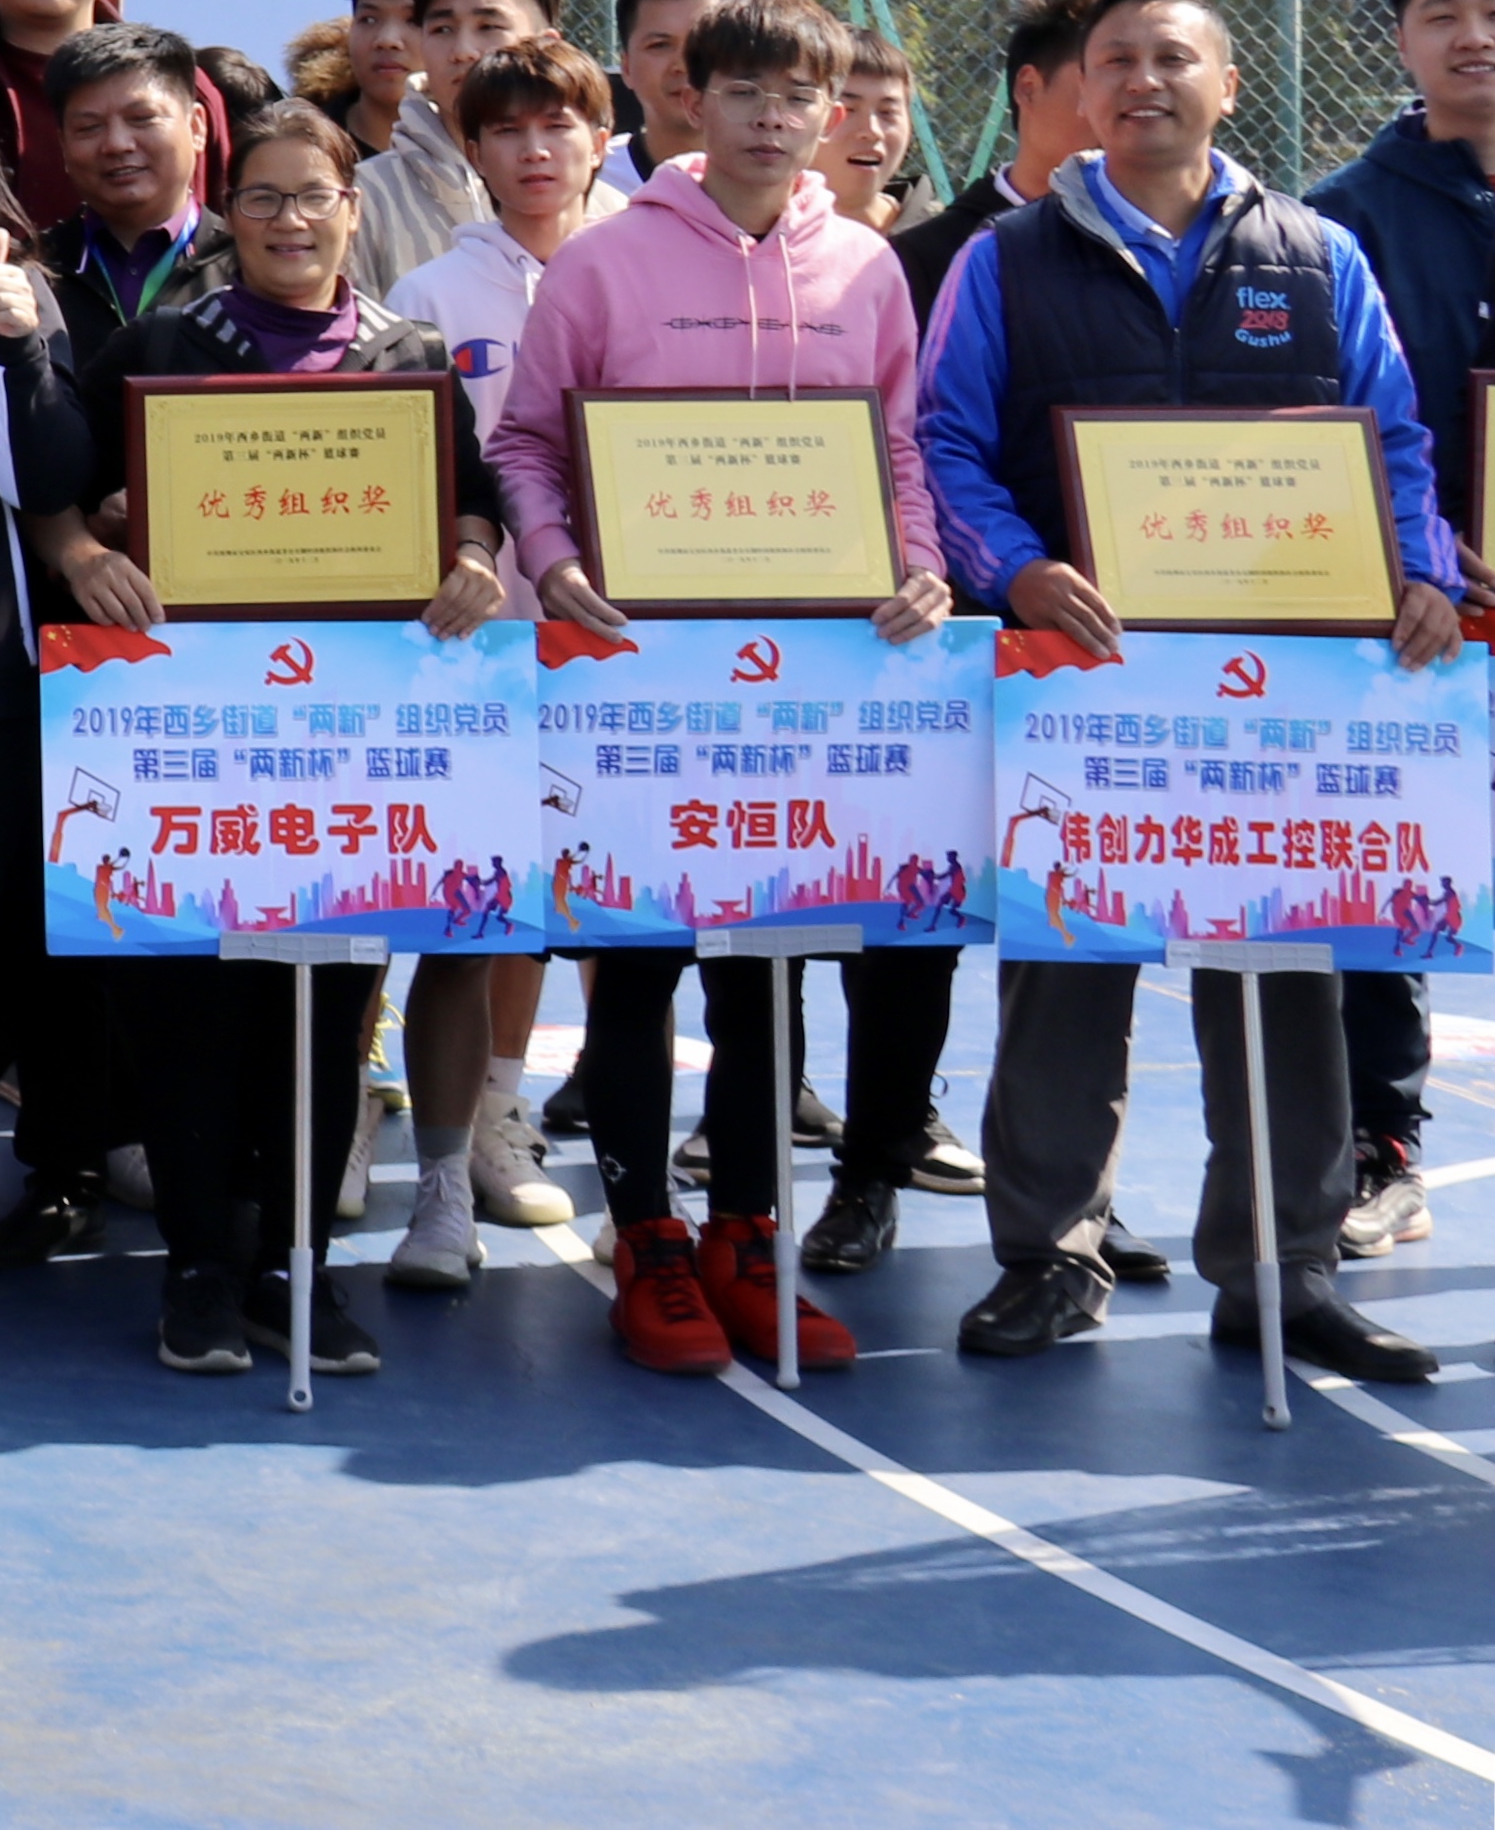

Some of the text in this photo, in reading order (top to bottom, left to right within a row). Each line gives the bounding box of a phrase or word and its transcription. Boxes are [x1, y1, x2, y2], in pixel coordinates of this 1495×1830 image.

[1234, 328, 1293, 348] Gushu
[197, 484, 392, 521] 优秀组织奖
[644, 487, 837, 522] 优秀组织奖
[1138, 509, 1335, 543] 优秀组织奖
[149, 802, 438, 857] 万威电子队
[670, 799, 836, 851] 安恒队
[1060, 812, 1431, 872] 伟创力华成工控联合队
